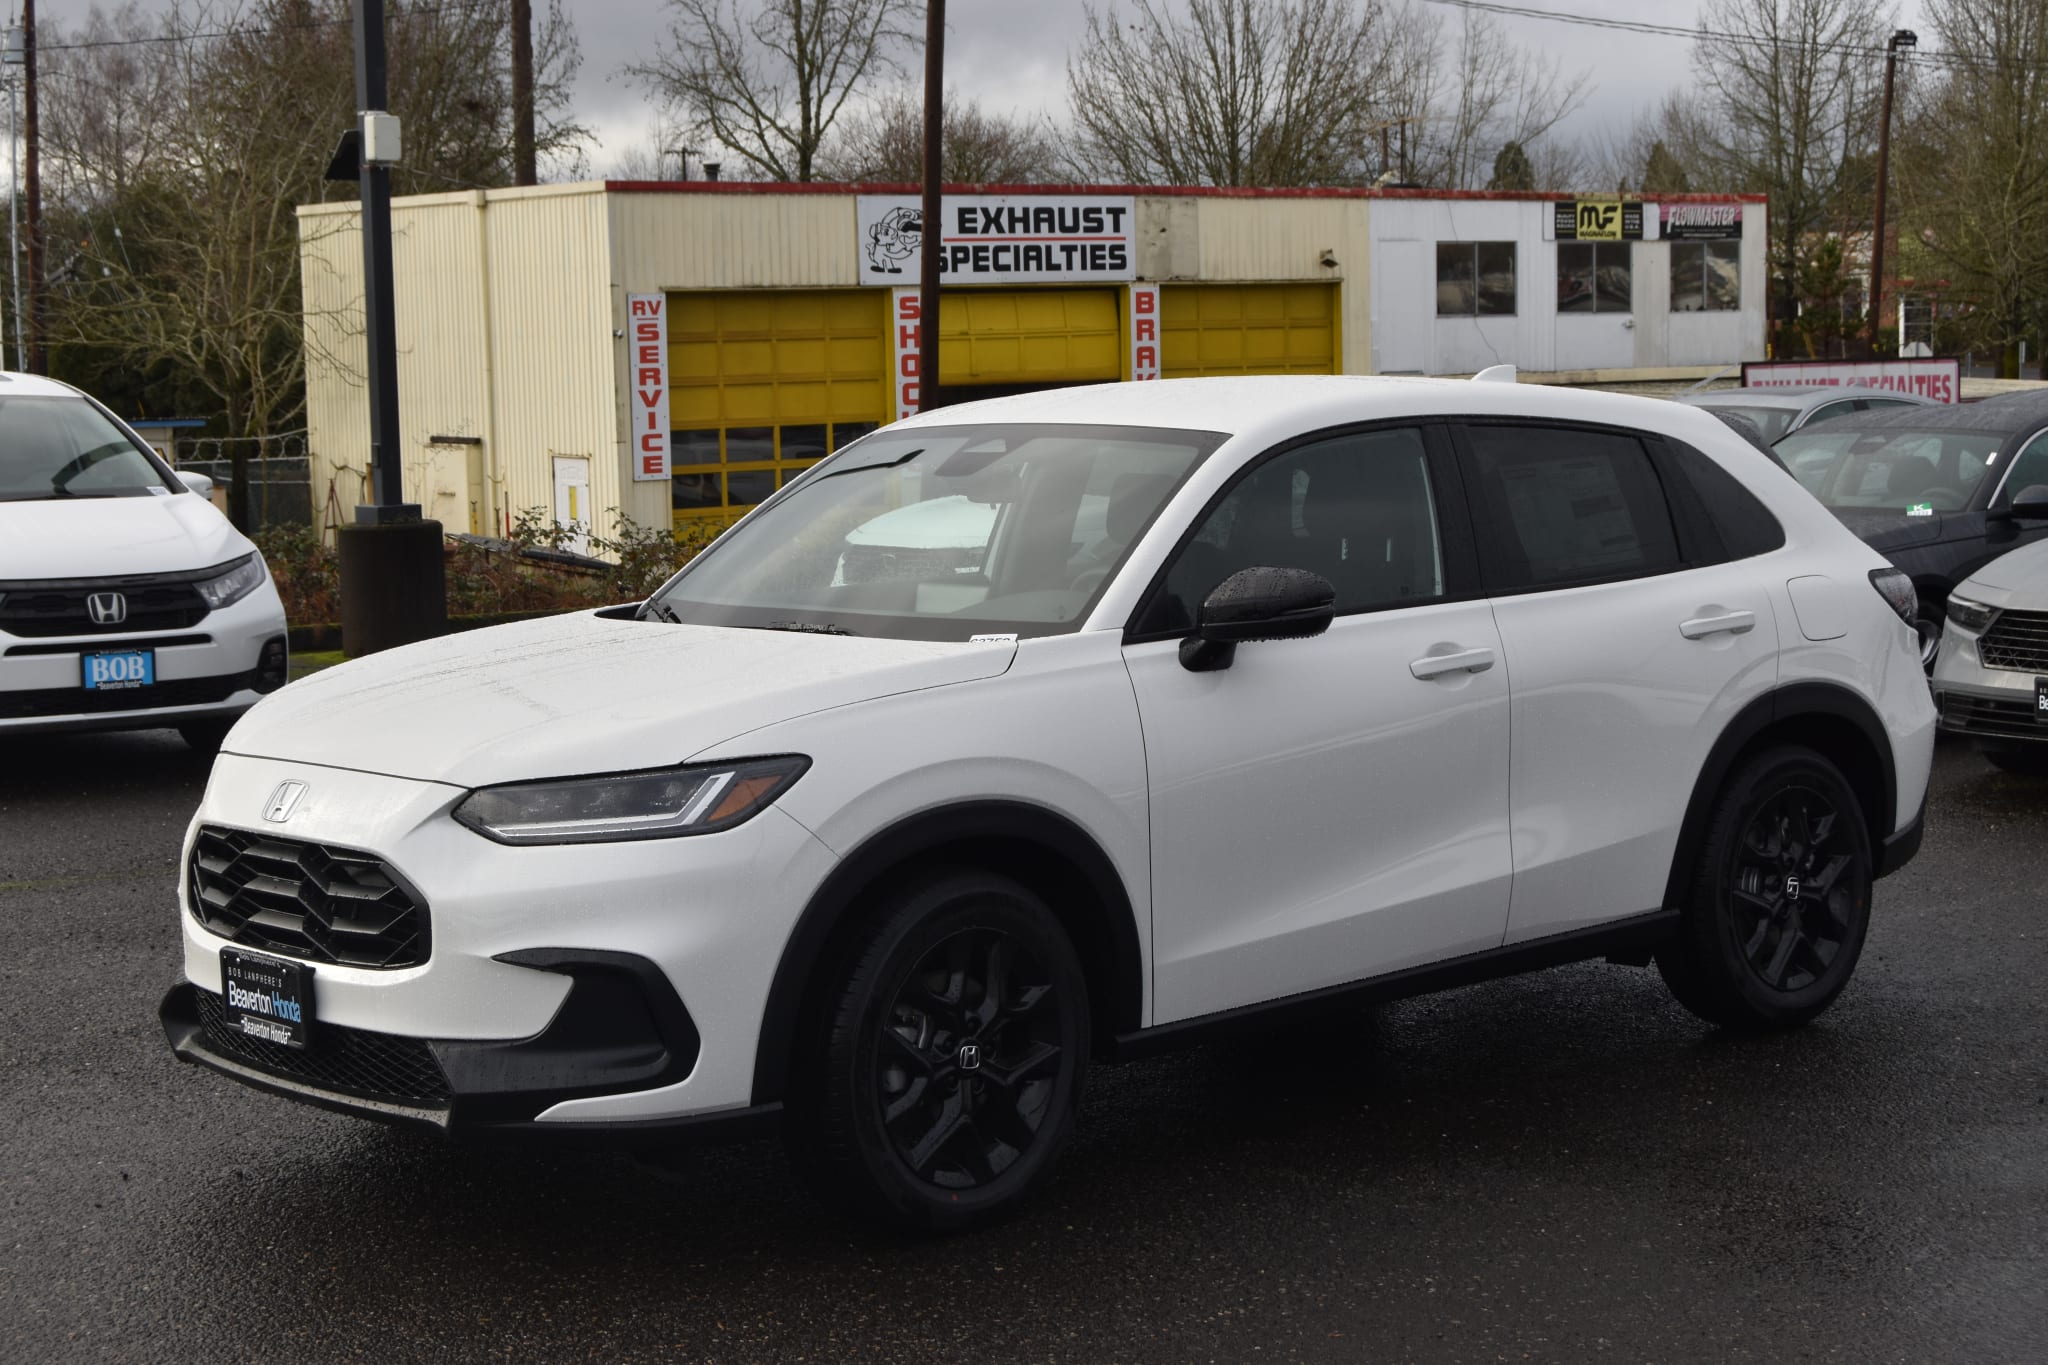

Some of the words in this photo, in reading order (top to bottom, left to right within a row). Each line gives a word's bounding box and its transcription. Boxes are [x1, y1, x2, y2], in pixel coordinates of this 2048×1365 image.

[957, 206, 1126, 235] EXHAUST
[1666, 207, 1735, 233] FLOWMASTER
[632, 300, 662, 316] RV
[899, 296, 921, 419] SHOC
[637, 322, 663, 474] SERVICE
[93, 656, 145, 682] BOB
[228, 966, 241, 978] BOB
[228, 980, 273, 1015] Beaverton
[271, 990, 301, 1024] Honda
[243, 1018, 270, 1040] Beaverton
[270, 1024, 289, 1045] Honda
